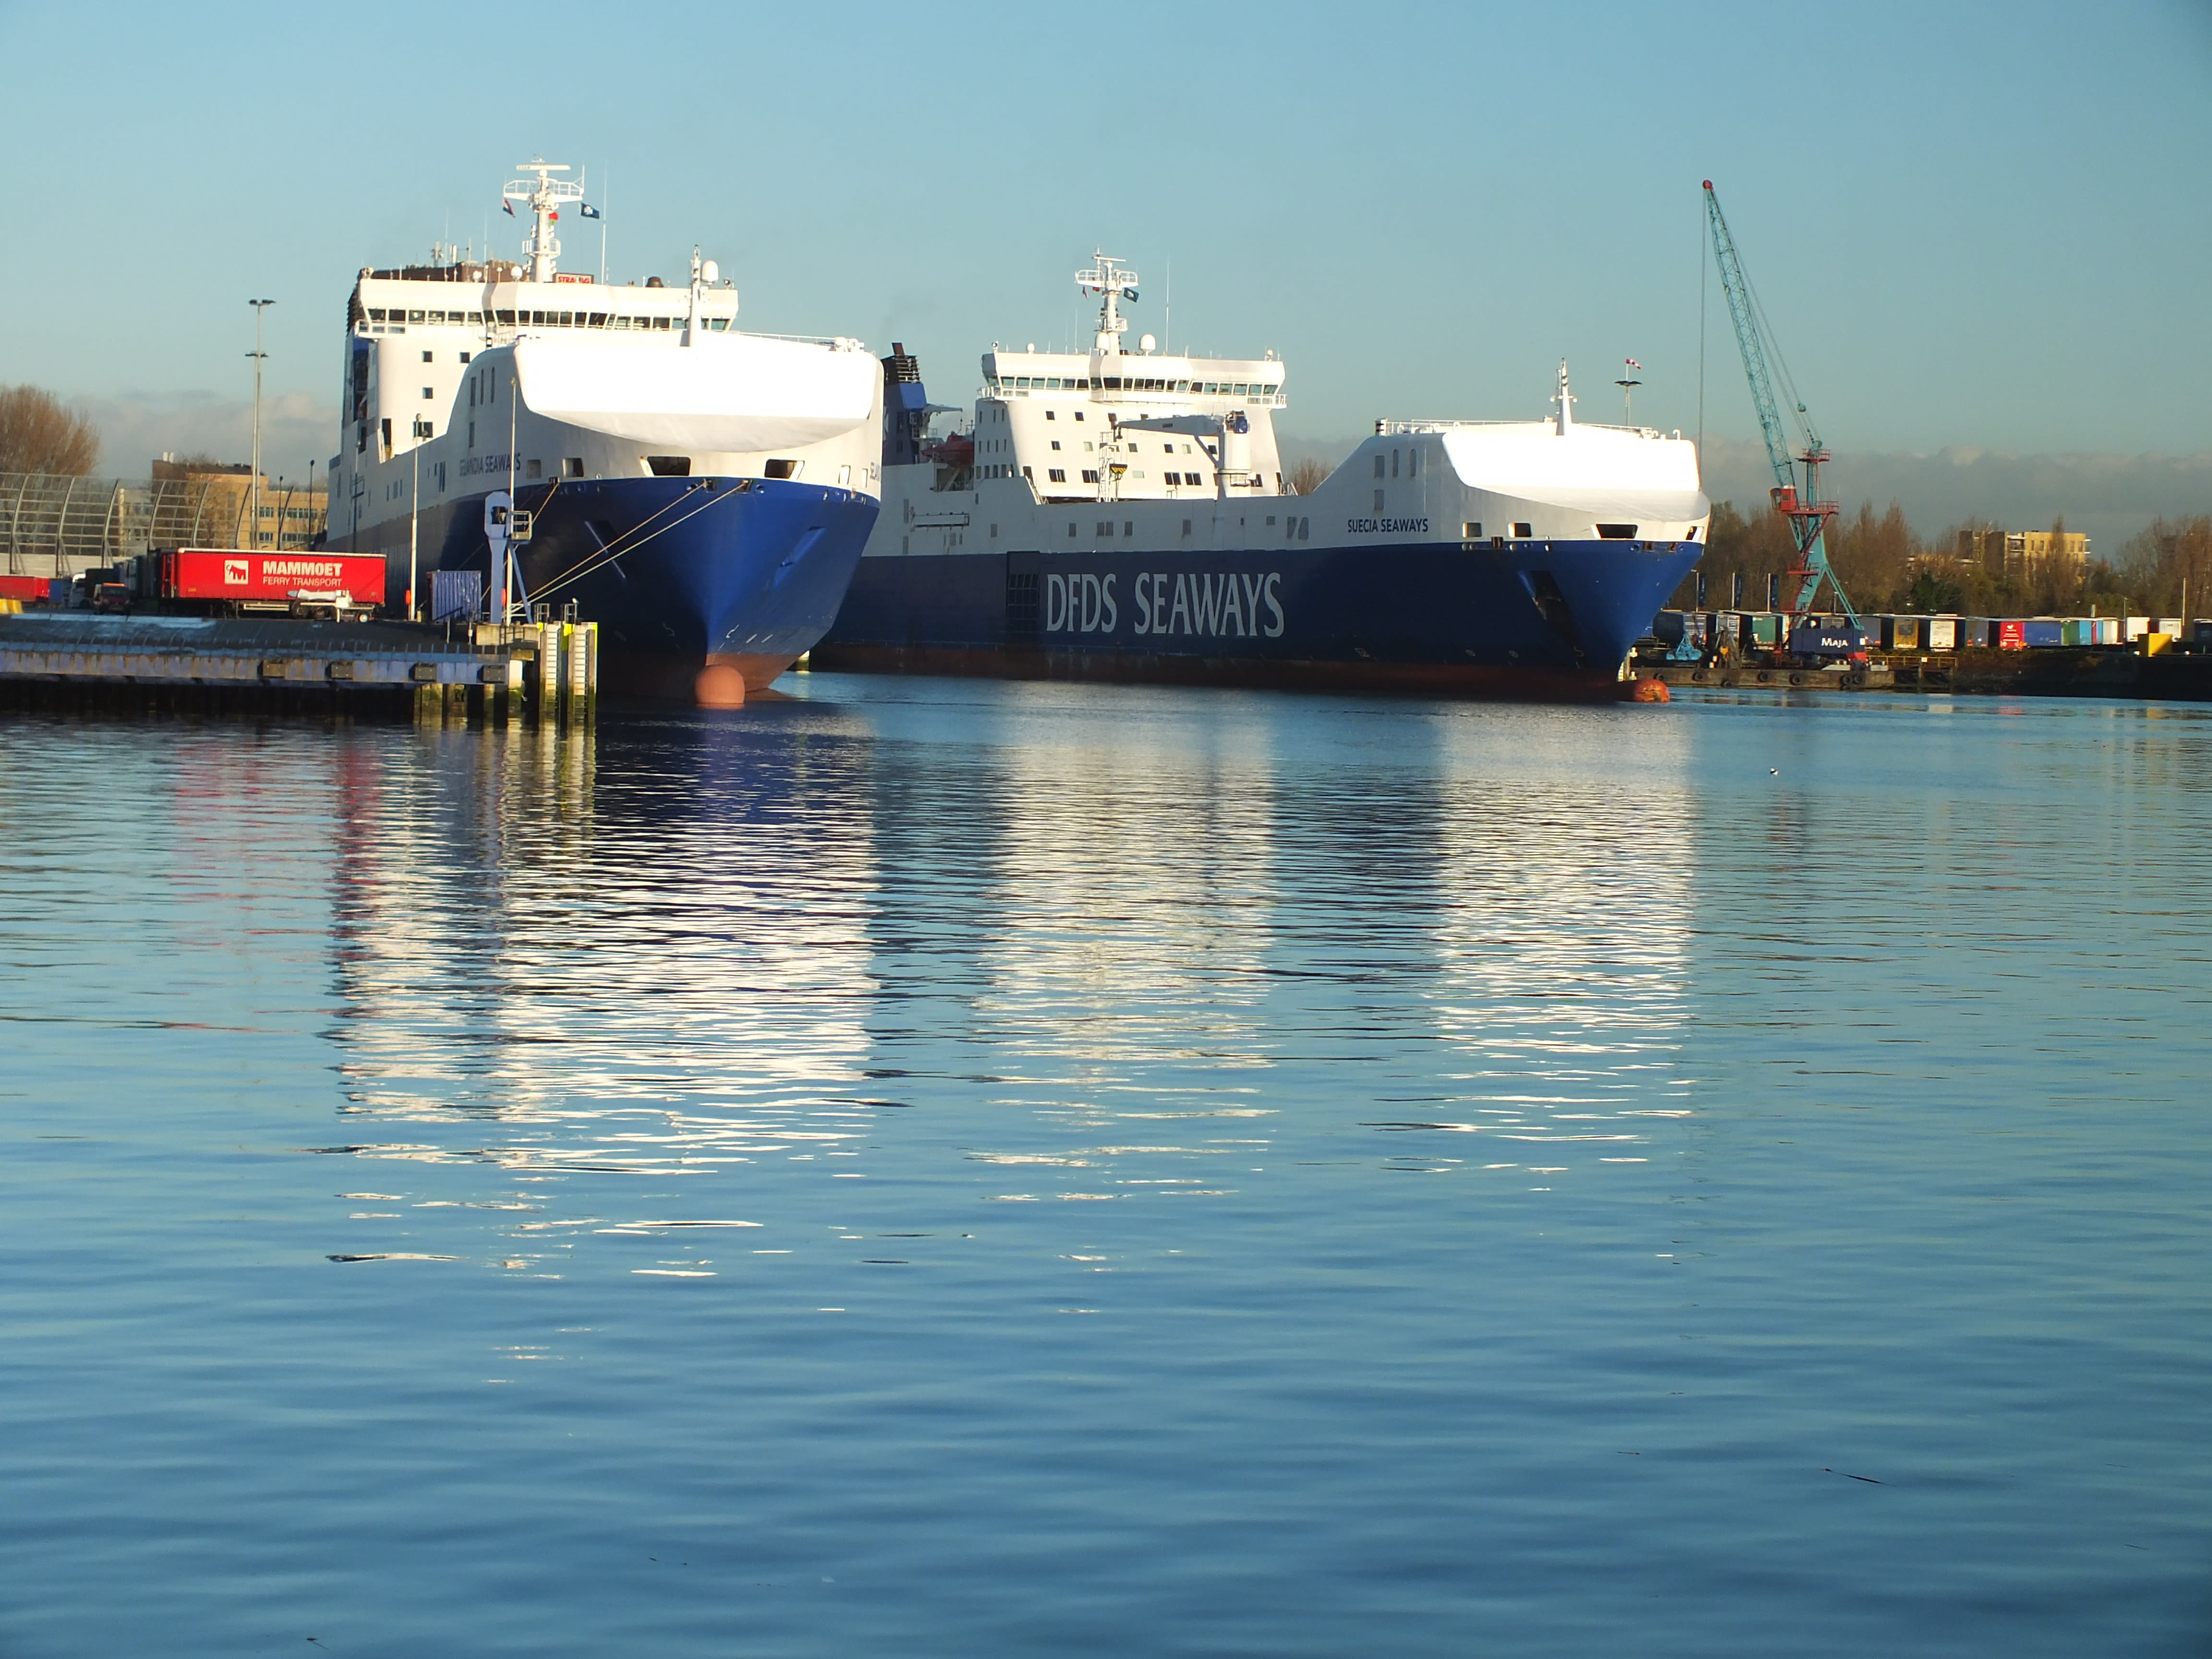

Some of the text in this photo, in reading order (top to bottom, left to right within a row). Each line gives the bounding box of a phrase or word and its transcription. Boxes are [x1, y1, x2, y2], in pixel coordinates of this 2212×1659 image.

[1347, 518, 1429, 533] SUECIA SEAWAYS
[263, 561, 343, 577] MAMMOET
[263, 577, 342, 587] FERRY TRANSPORT
[1046, 572, 1285, 637] DFDS SEAWAYS
